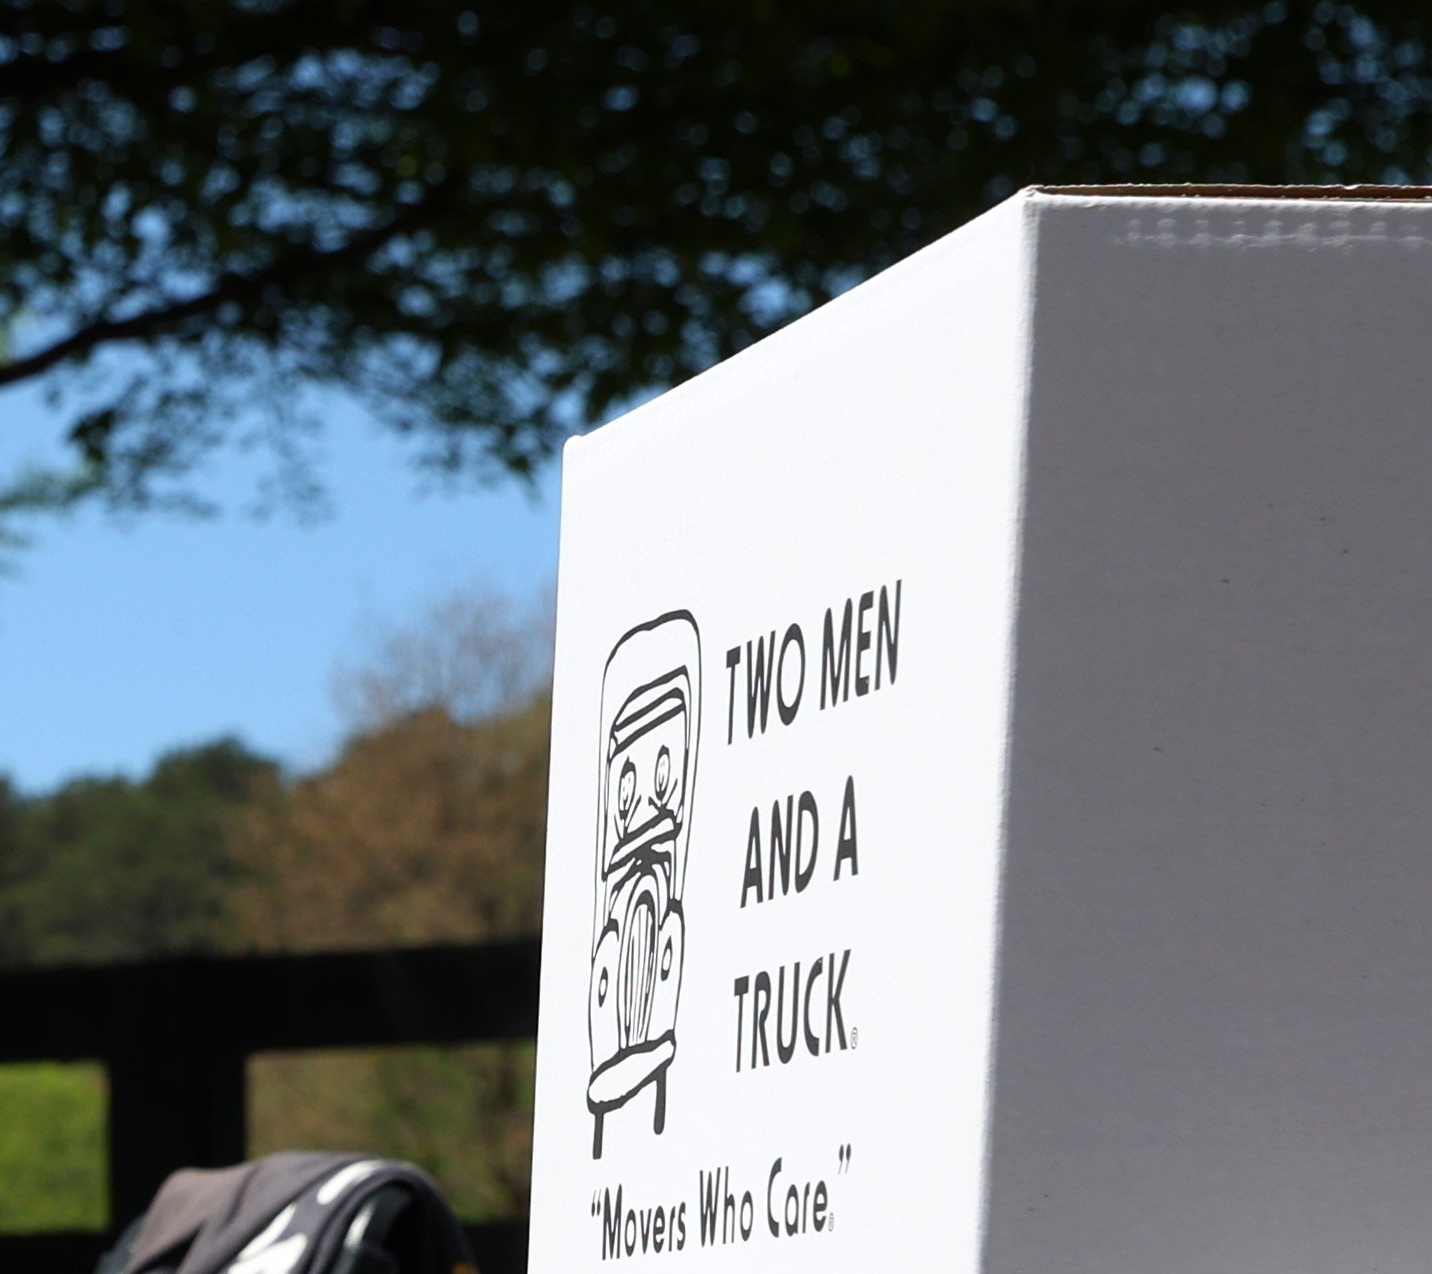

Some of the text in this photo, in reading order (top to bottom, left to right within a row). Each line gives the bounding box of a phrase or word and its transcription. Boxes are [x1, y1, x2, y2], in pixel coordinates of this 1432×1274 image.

[726, 579, 902, 745] TWO MEN
[740, 775, 858, 908] AND A
[699, 1166, 753, 1247] Who
